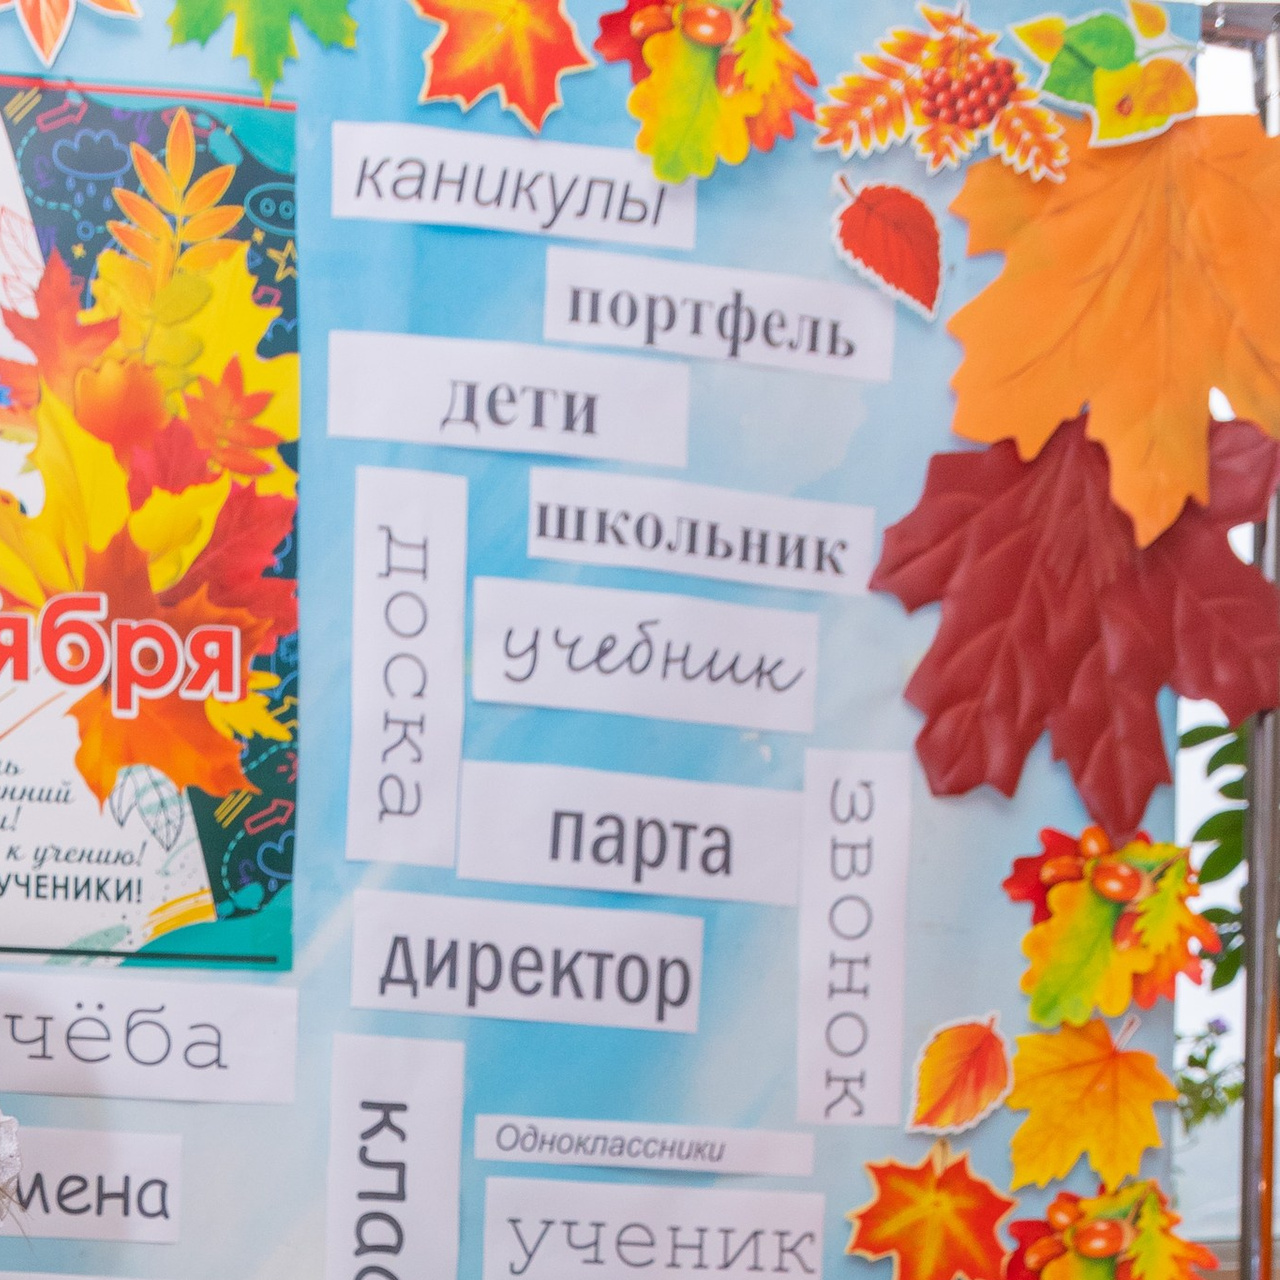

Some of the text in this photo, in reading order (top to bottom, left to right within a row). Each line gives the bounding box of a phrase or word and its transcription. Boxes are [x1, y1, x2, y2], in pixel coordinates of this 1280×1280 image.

[355, 154, 668, 230] каникулы
[567, 283, 857, 360] портфель
[440, 376, 600, 438] дети
[536, 500, 850, 578] школьник
[376, 524, 430, 823] доска
[503, 617, 805, 694] учебник
[3, 843, 23, 862] к
[31, 842, 145, 872] учению!
[548, 807, 733, 884] парта
[378, 934, 693, 1023] директор
[824, 778, 875, 1119] звонок
[495, 1122, 726, 1164] Одноклассники
[507, 1215, 818, 1276] ученик
